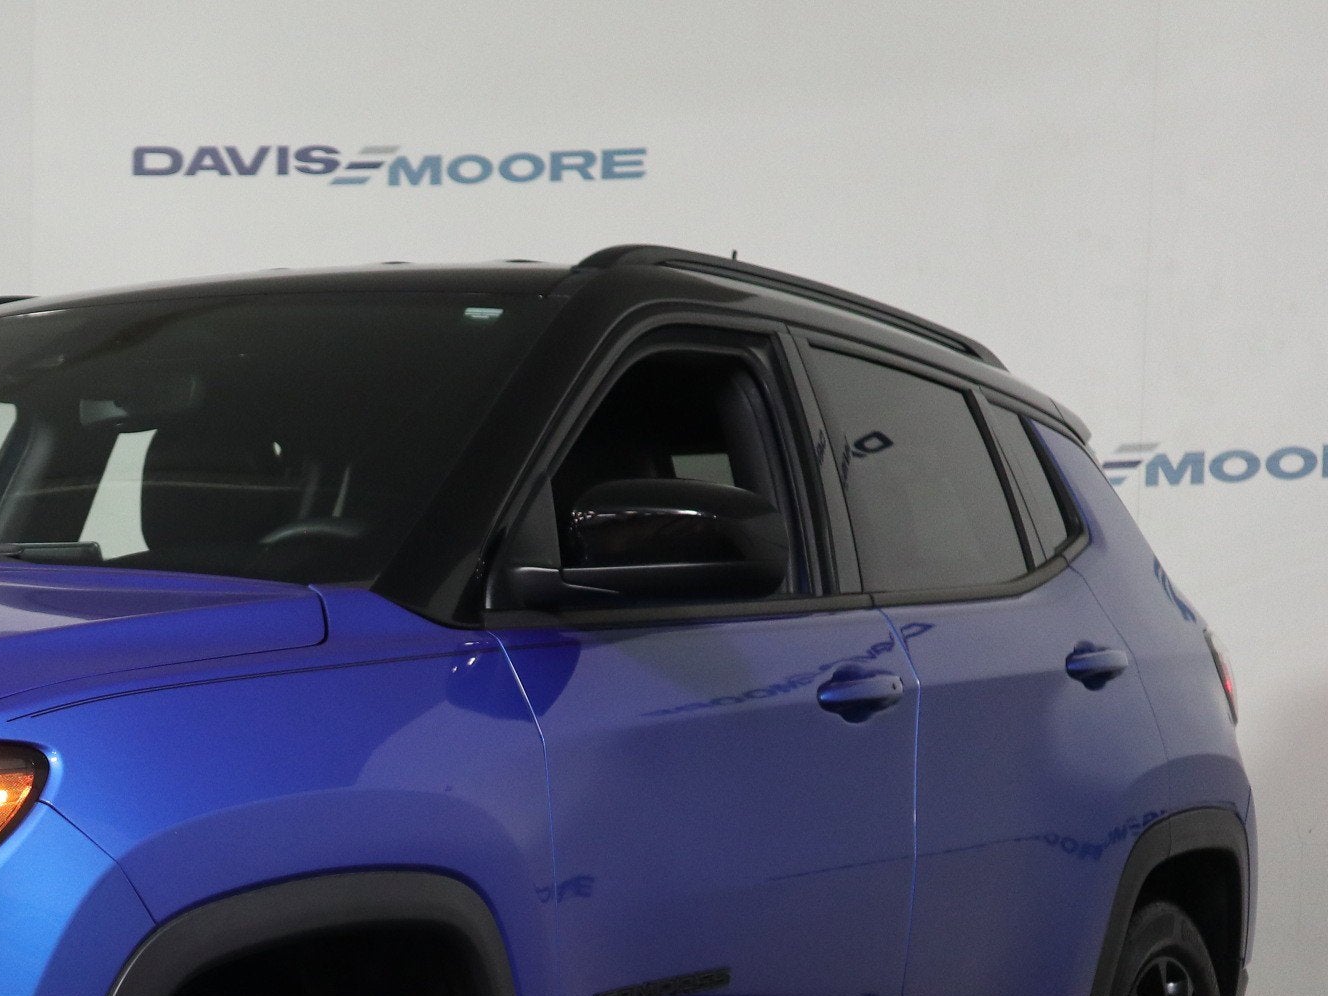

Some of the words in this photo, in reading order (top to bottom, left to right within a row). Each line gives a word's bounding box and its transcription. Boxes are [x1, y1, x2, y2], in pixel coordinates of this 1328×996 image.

[131, 144, 341, 177] DAVIS
[387, 147, 647, 186] MOORE
[1144, 444, 1328, 487] MOO
